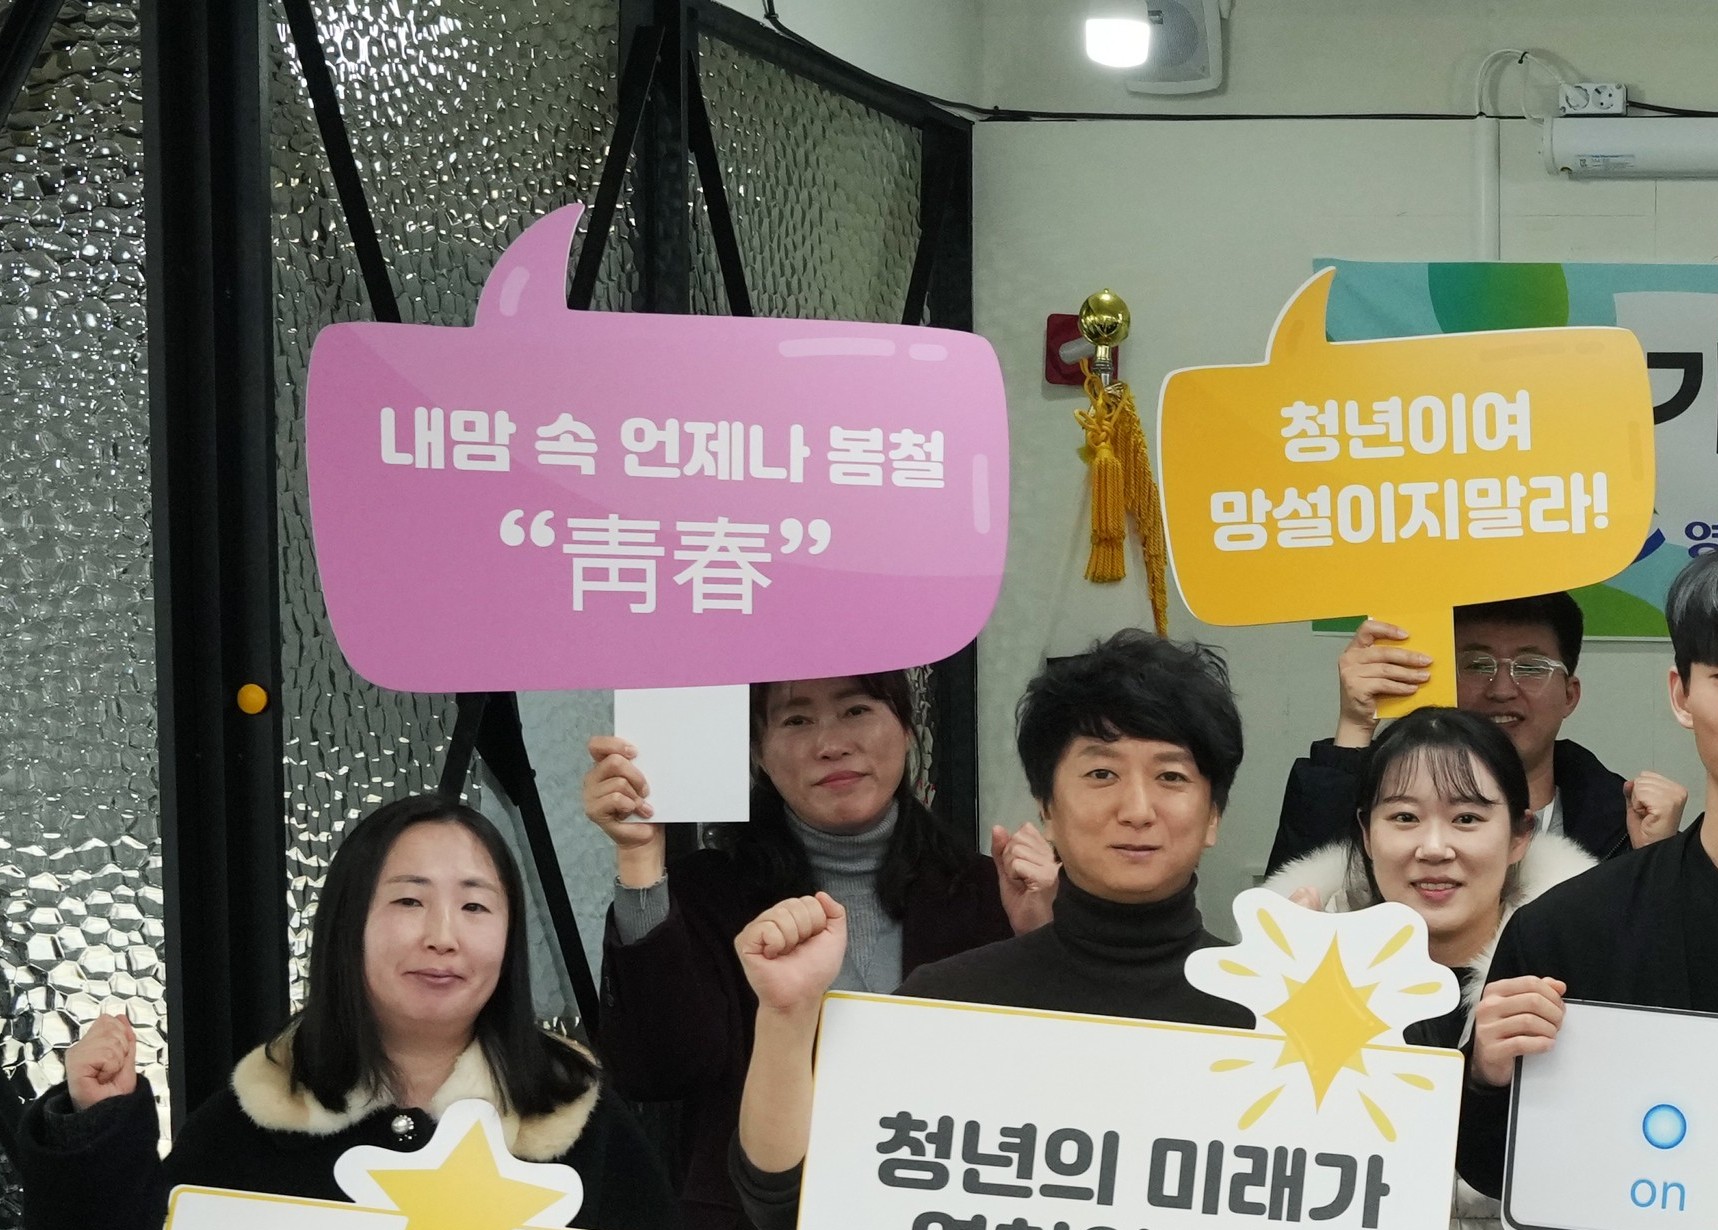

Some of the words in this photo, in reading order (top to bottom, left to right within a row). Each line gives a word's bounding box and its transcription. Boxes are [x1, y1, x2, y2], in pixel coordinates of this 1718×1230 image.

[381, 407, 516, 471] 내맘
[535, 413, 598, 475] 속
[621, 418, 810, 482] 언제나
[828, 426, 944, 488] 봄철
[1281, 389, 1531, 462] 청년이여
[1211, 472, 1609, 551] 망설이지말라!
[876, 1111, 1119, 1206] 청년의
[1147, 1138, 1390, 1229] 미래가
[1631, 1179, 1685, 1211] on
